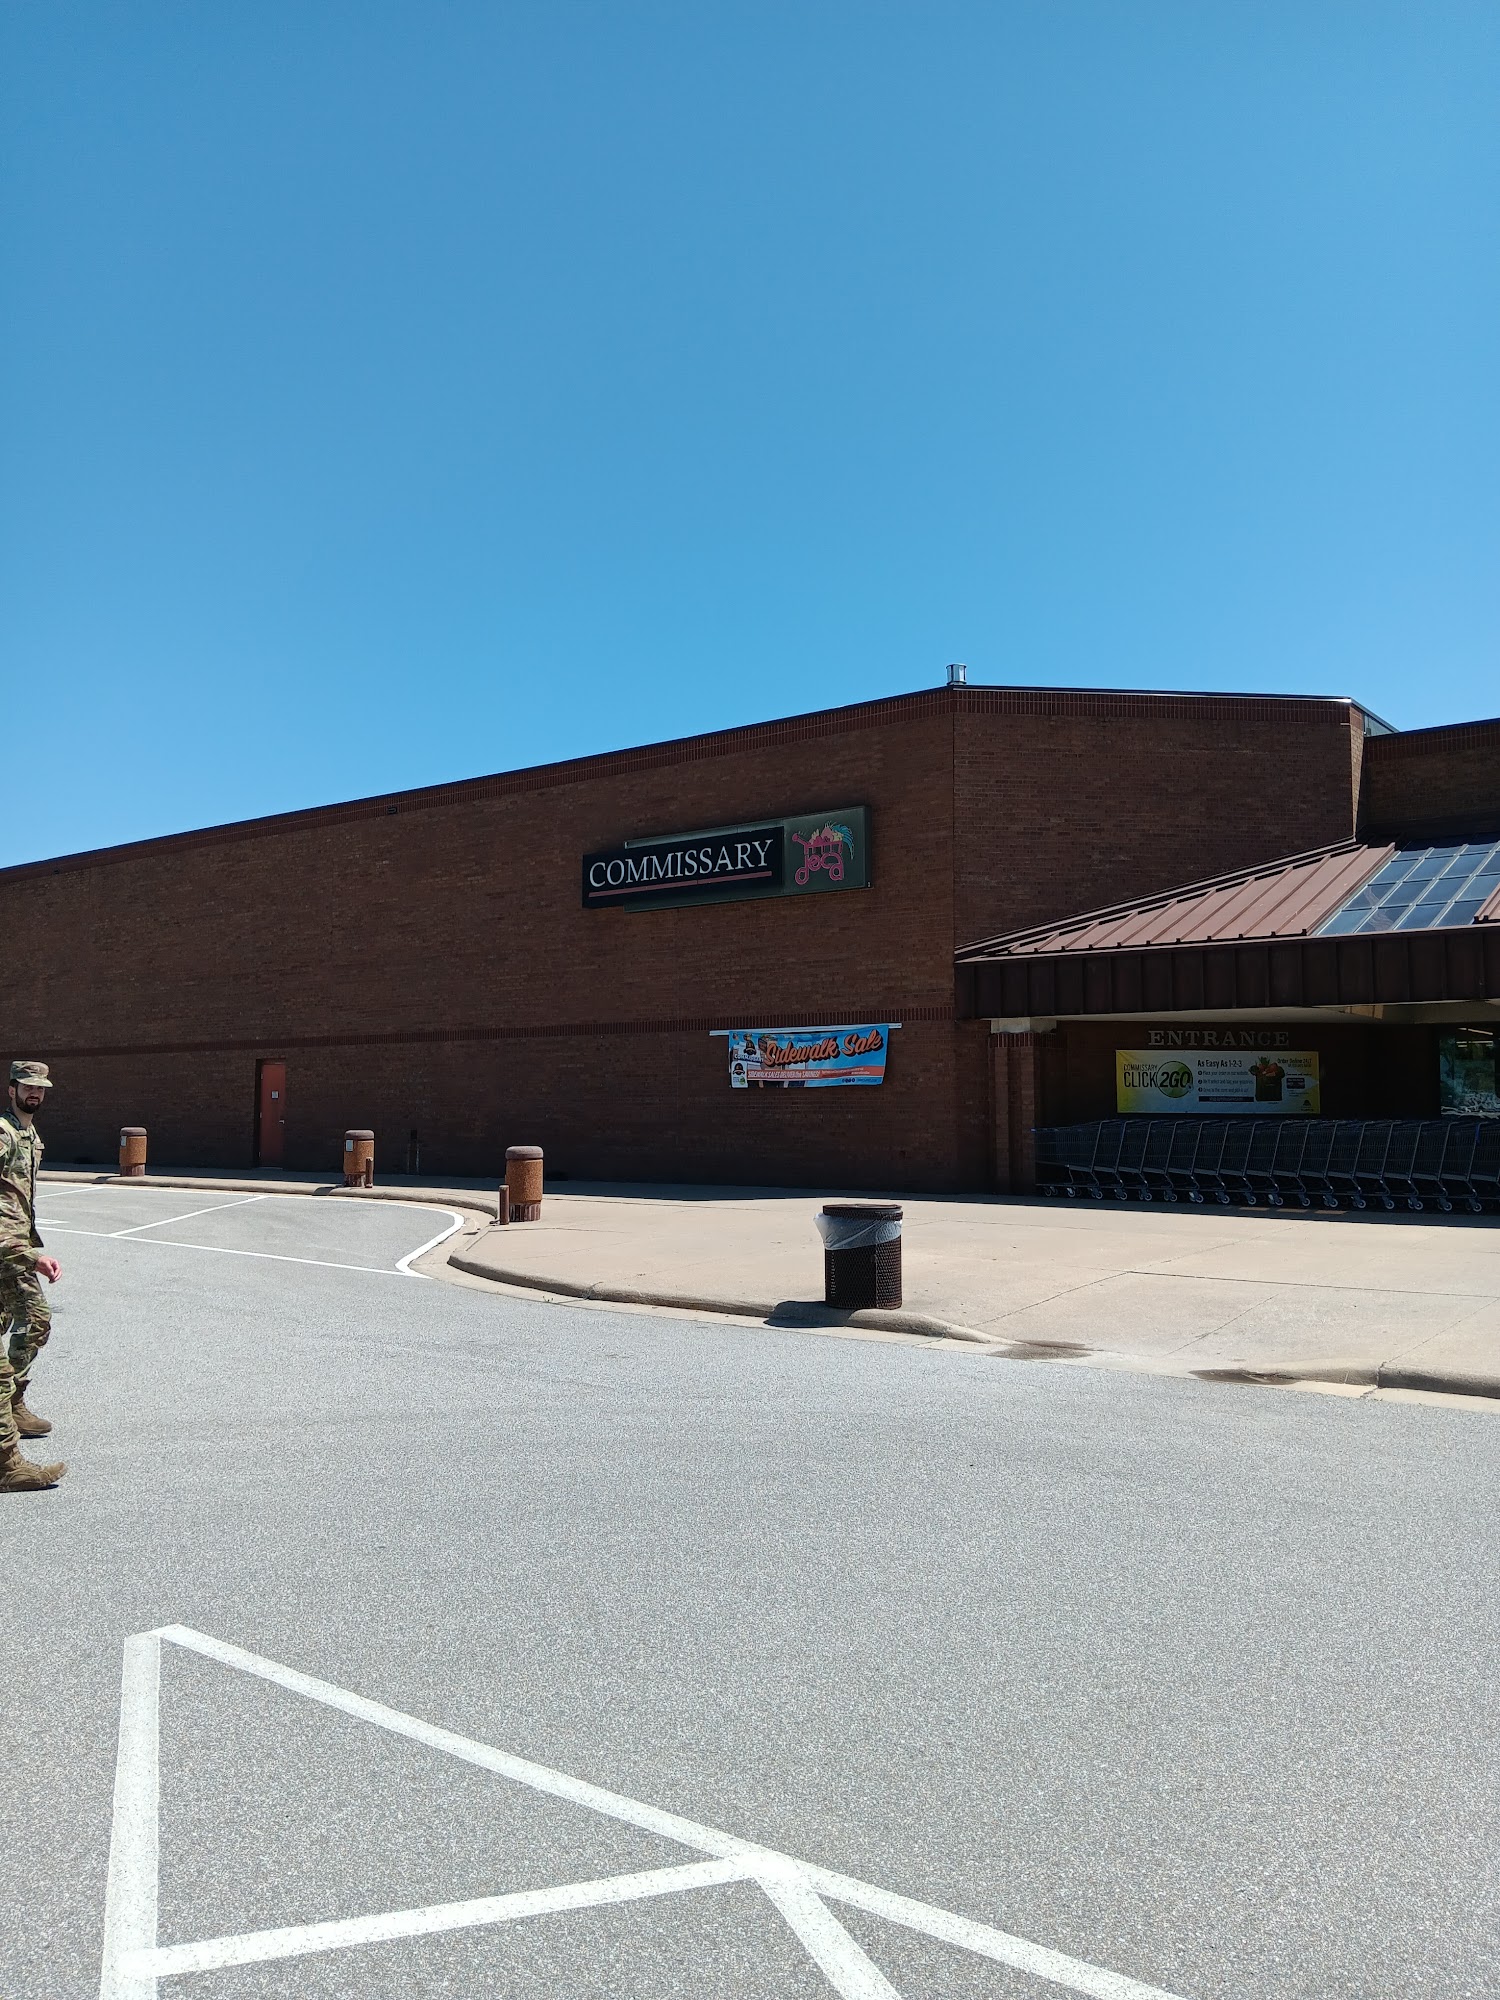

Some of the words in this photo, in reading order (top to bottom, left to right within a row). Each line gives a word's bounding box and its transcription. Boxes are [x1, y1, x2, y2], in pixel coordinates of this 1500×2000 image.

[589, 839, 773, 887] COMMISSARY
[1148, 1030, 1289, 1046] ENTRANCE
[764, 1036, 839, 1067] Sidewalk
[841, 1029, 882, 1055] Sale
[1123, 1063, 1158, 1071] COMMISSARY
[1206, 1060, 1219, 1069] Easy
[748, 1070, 768, 1079] SIDEWALK
[768, 1070, 780, 1079] SALES
